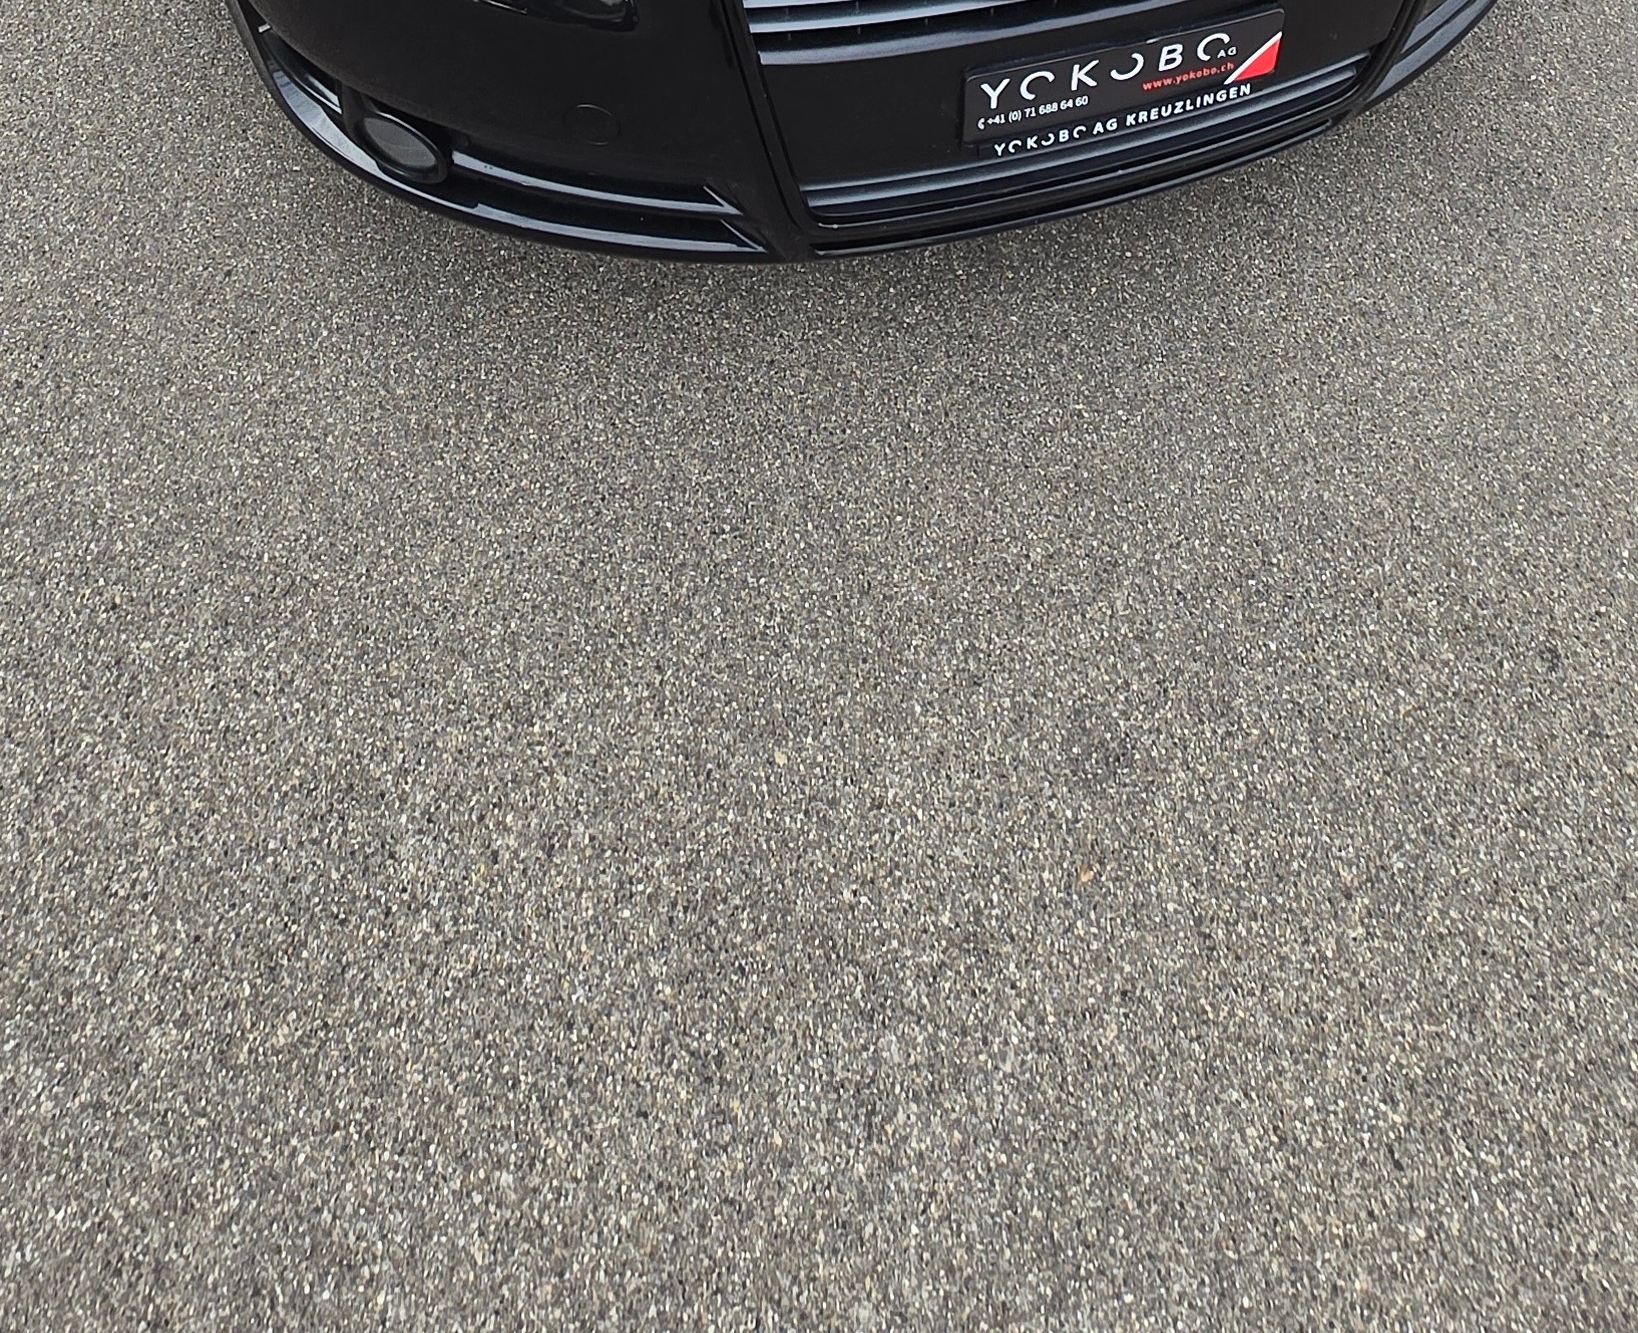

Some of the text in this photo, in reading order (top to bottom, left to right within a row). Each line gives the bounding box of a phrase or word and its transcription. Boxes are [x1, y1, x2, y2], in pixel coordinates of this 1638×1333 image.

[980, 32, 1237, 110] YOKOBO AG
[1142, 61, 1235, 91] www.yokobo.ch
[987, 95, 1089, 125] +41 (0) 71 688 64 60
[994, 82, 1251, 157] YOKOBO AG KREUZLINGEN
